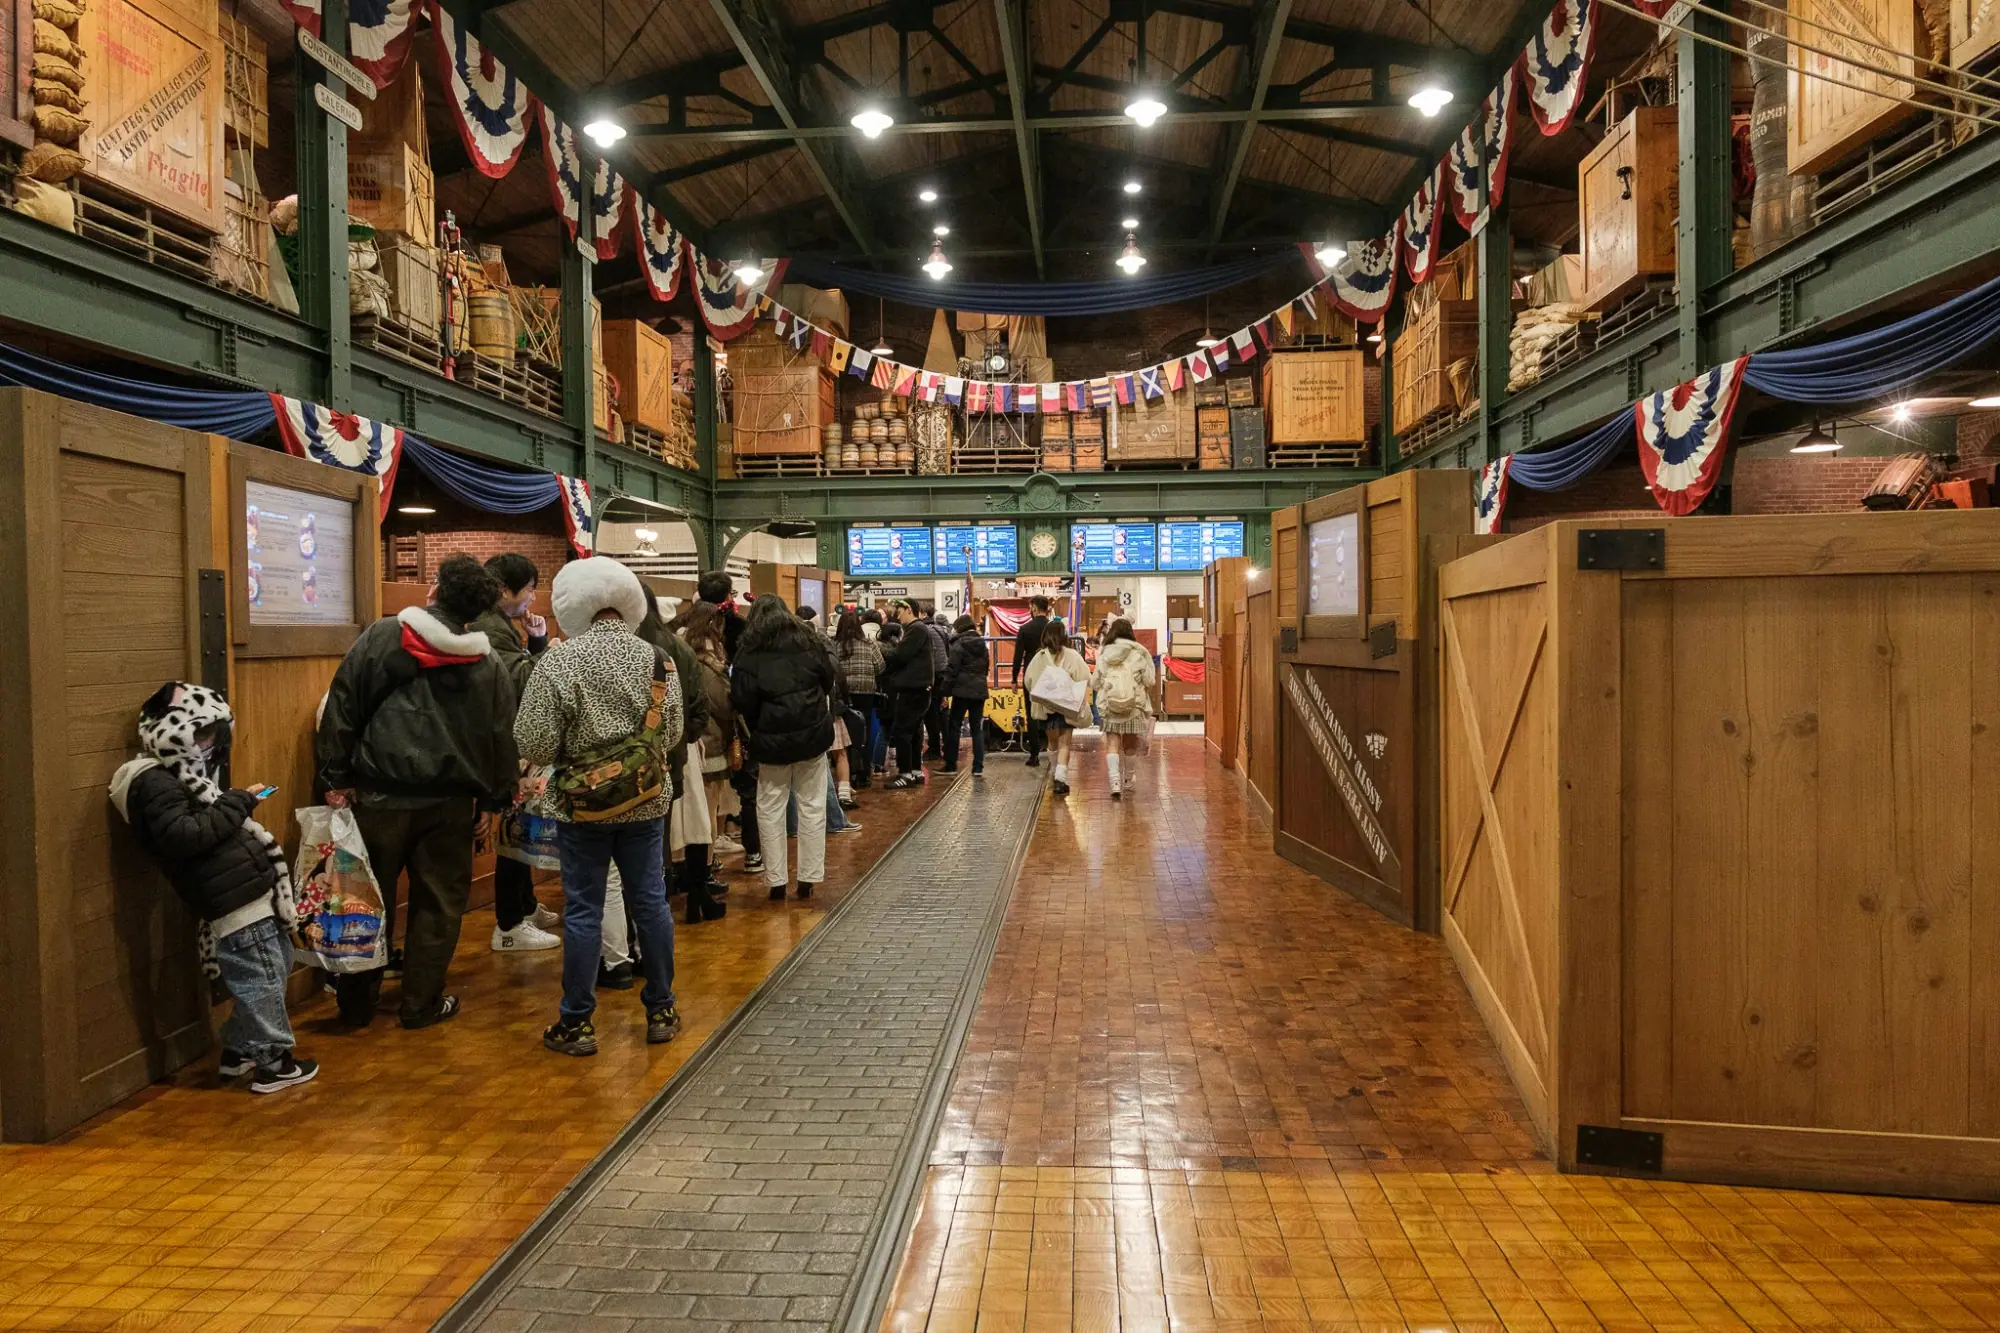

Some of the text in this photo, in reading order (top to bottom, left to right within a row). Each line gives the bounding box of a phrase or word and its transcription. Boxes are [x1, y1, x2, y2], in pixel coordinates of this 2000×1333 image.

[303, 35, 371, 92] CONSTANTINOPLE
[97, 127, 123, 155] AUNT
[122, 104, 151, 134] PEG'S
[149, 74, 185, 110] VILLAGE
[184, 50, 211, 79] STORE
[119, 77, 207, 162] ASSTD. CONFECTIONS
[320, 91, 358, 123] SALERNO
[148, 150, 208, 198] Fragile
[944, 595, 954, 608] 2
[1123, 592, 1132, 606] 3
[1288, 674, 1387, 864] AUNT PEG'S VILLAGE STORE
[1305, 668, 1383, 813] ASSTD. CONFECTIONS
